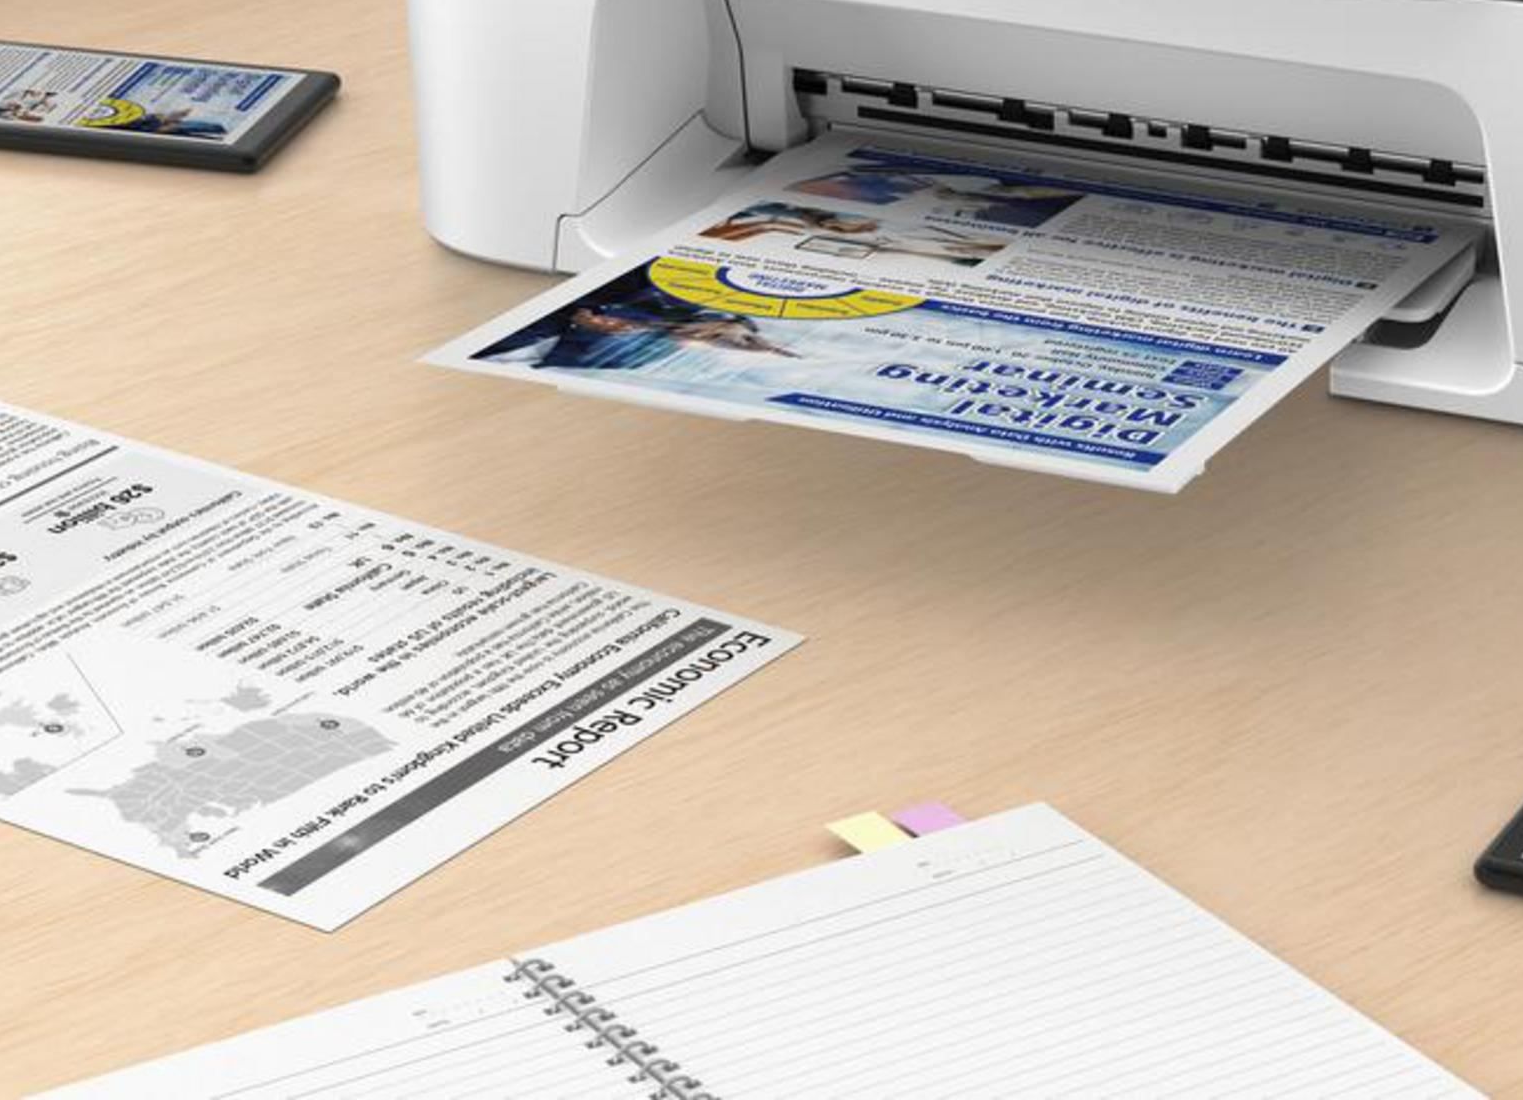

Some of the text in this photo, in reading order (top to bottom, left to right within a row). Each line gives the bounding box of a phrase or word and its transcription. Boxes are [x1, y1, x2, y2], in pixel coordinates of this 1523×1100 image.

[981, 273, 1301, 329] The benefits of digital marketing
[863, 361, 1191, 428] Marketing
[954, 358, 1209, 411] Seminar
[944, 396, 1167, 446] Digital
[41, 500, 120, 536] billion
[328, 570, 559, 699] Largest-scale economies in the world,
[363, 565, 541, 664] including results of US states
[609, 606, 687, 647] California
[546, 641, 626, 682] Economy
[489, 623, 718, 755] The economy as seen from data
[492, 678, 566, 716] Exceeds
[518, 629, 776, 771] Economic Report
[447, 711, 511, 744] United
[372, 738, 464, 786] Kingdom's
[319, 792, 373, 819] Rank
[356, 781, 392, 797] to
[267, 835, 301, 851] in
[283, 814, 337, 841] Fifth
[216, 846, 284, 880] World
